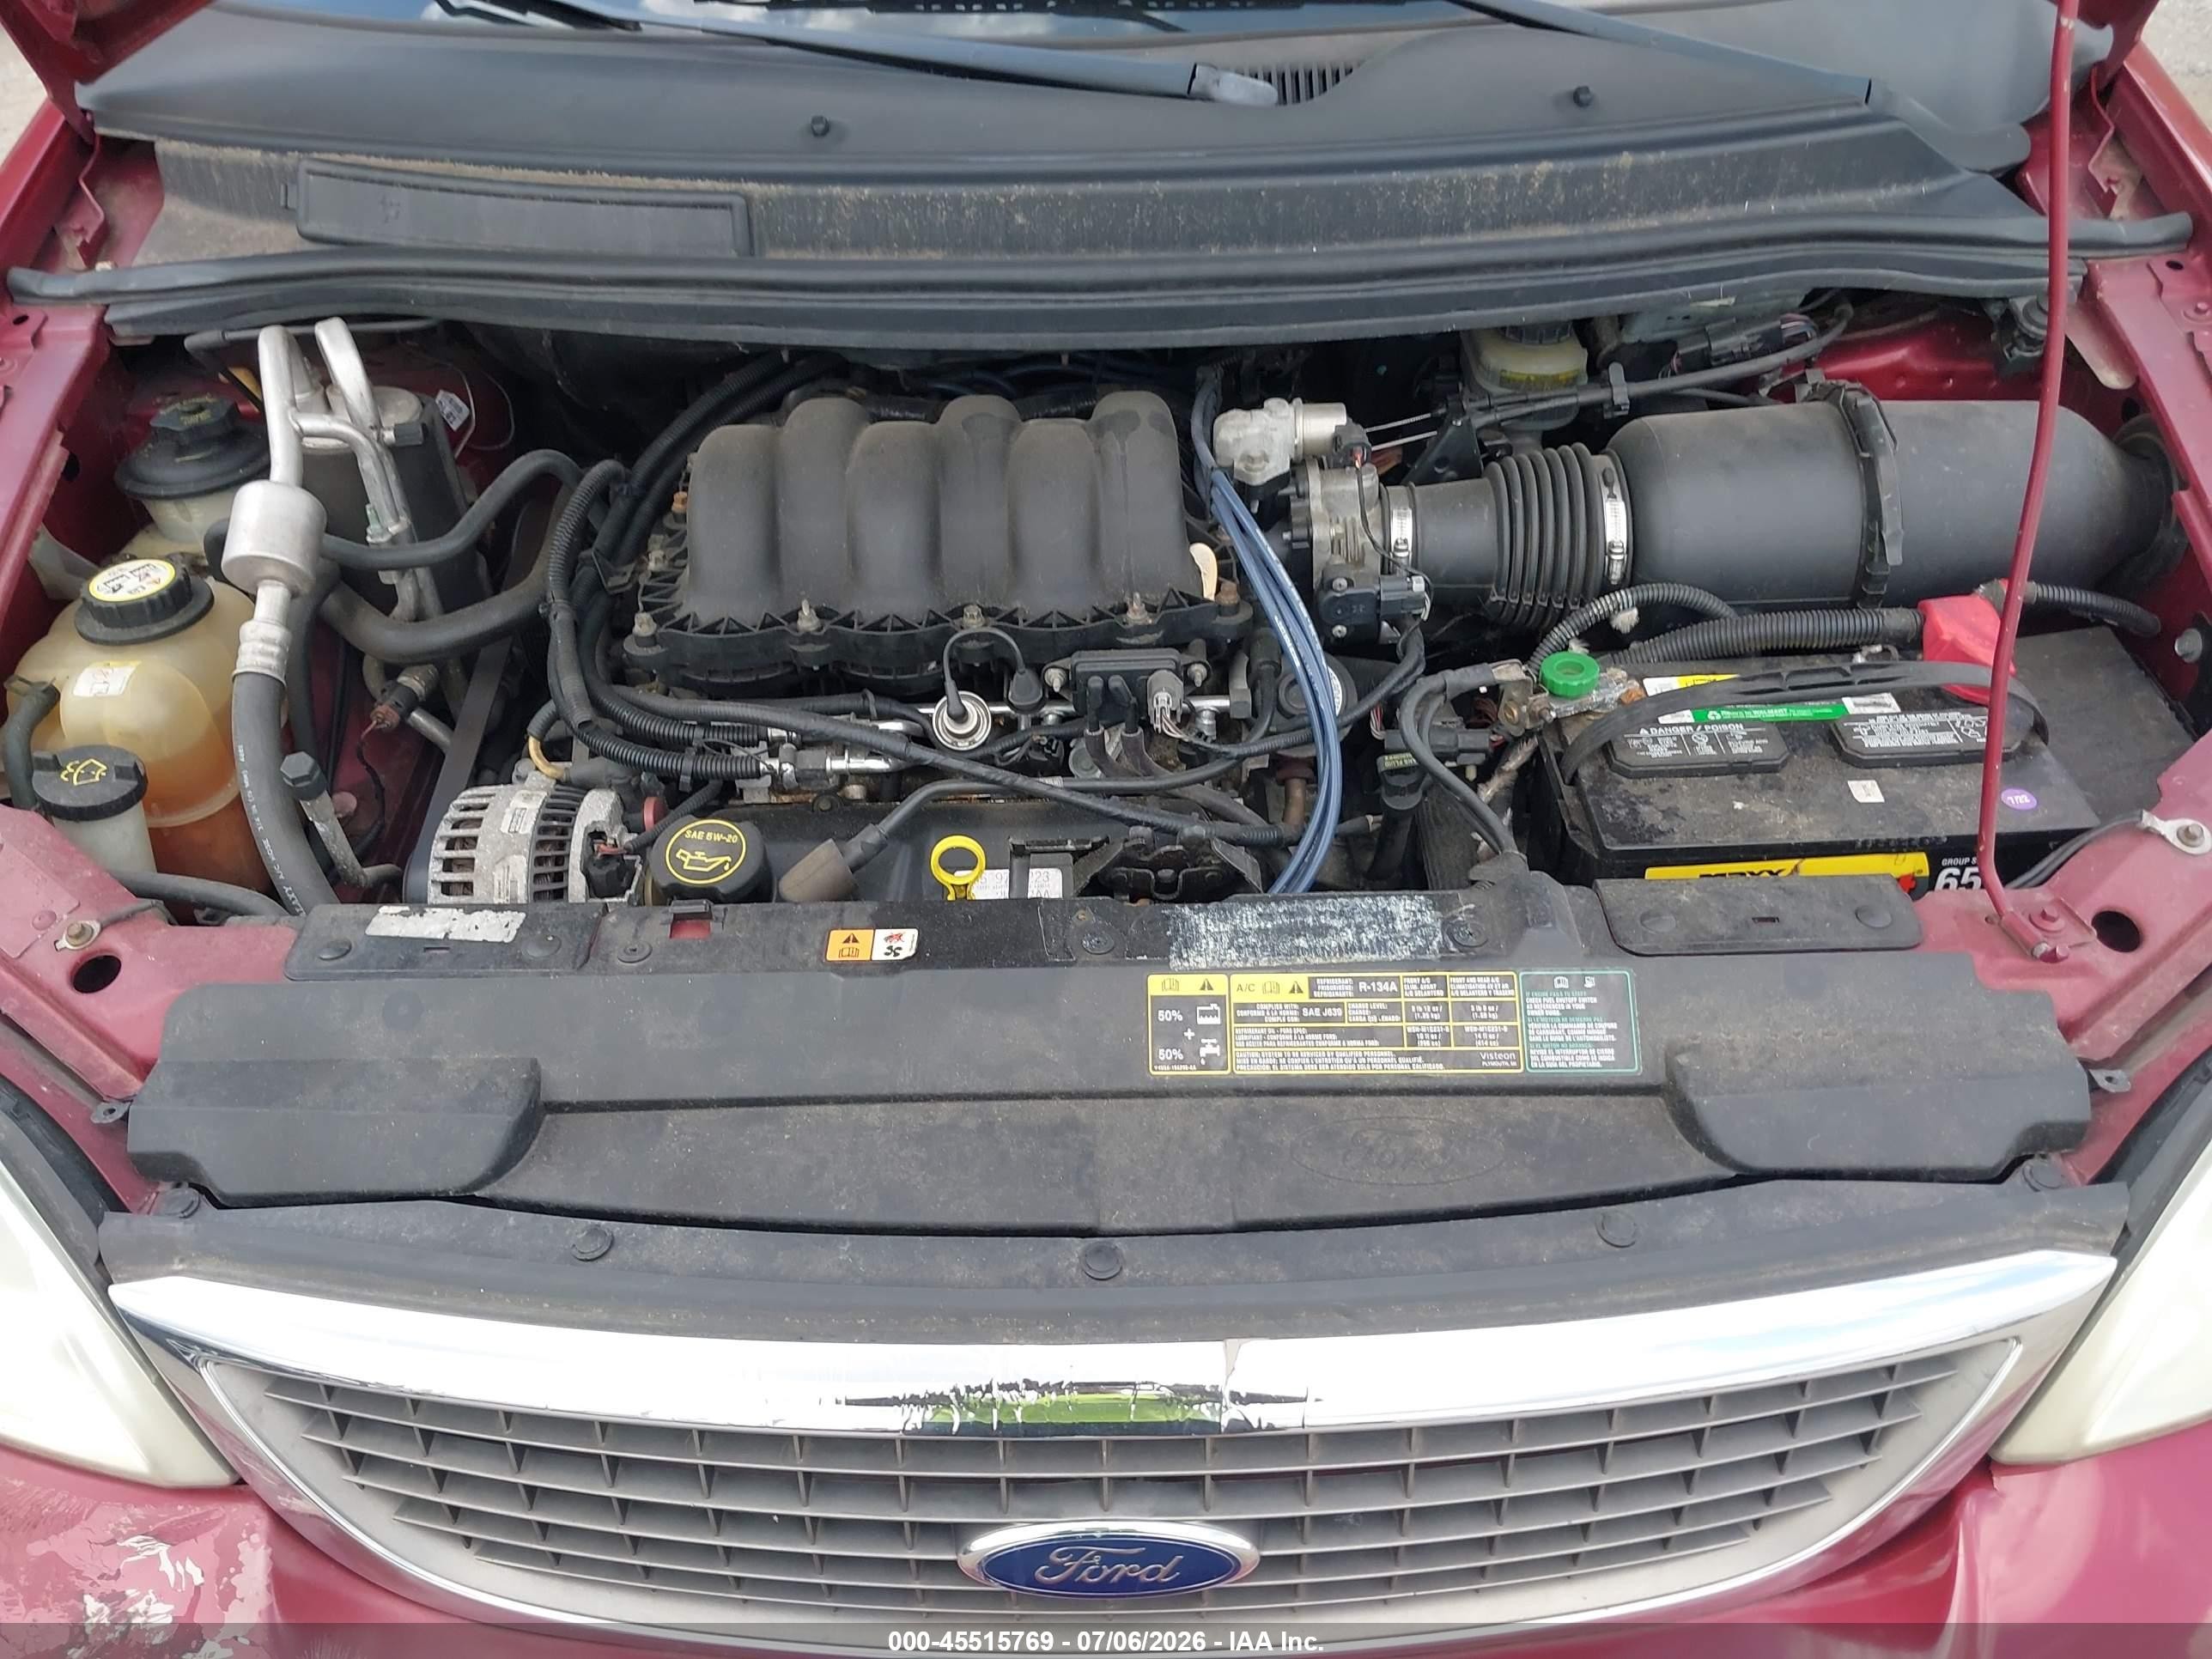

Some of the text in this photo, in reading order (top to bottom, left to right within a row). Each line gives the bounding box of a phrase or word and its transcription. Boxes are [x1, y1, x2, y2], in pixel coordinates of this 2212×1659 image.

[684, 830, 738, 843] SAE 5W-20
[1942, 857, 1971, 866] GROUP
[1934, 866, 1982, 891] 65
[1236, 983, 1255, 992] A/C
[1358, 981, 1398, 993] R-134A
[1158, 1010, 1183, 1021] 50%
[1158, 1048, 1184, 1060] 50%
[1035, 1546, 1184, 1584] Ford
